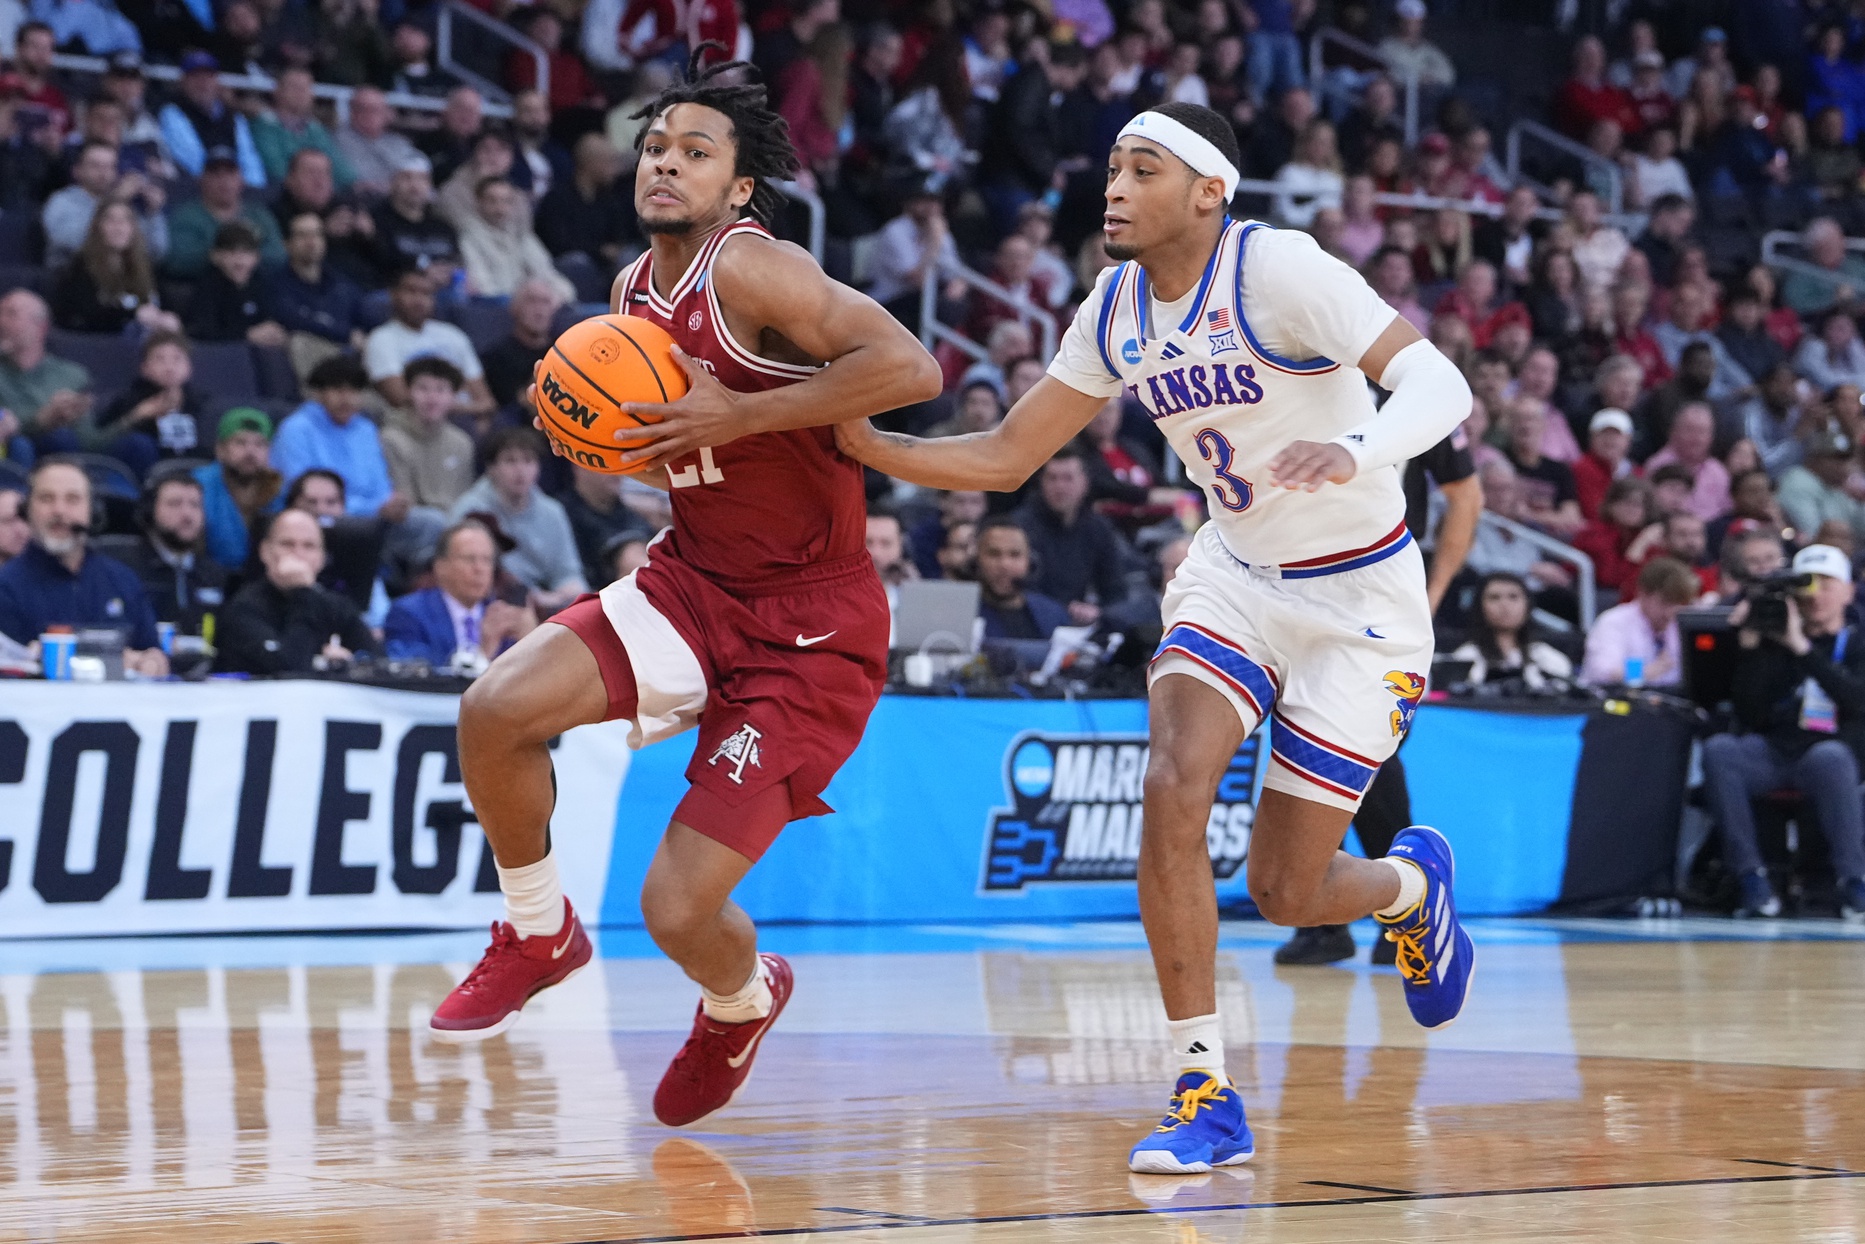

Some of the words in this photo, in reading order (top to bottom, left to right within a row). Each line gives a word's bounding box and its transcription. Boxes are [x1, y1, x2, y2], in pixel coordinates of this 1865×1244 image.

[541, 371, 600, 430] NCAA
[1192, 428, 1253, 513] 3
[1050, 744, 1151, 801] MAR
[0, 719, 560, 904] OLLEG
[1063, 803, 1254, 862] MASS
